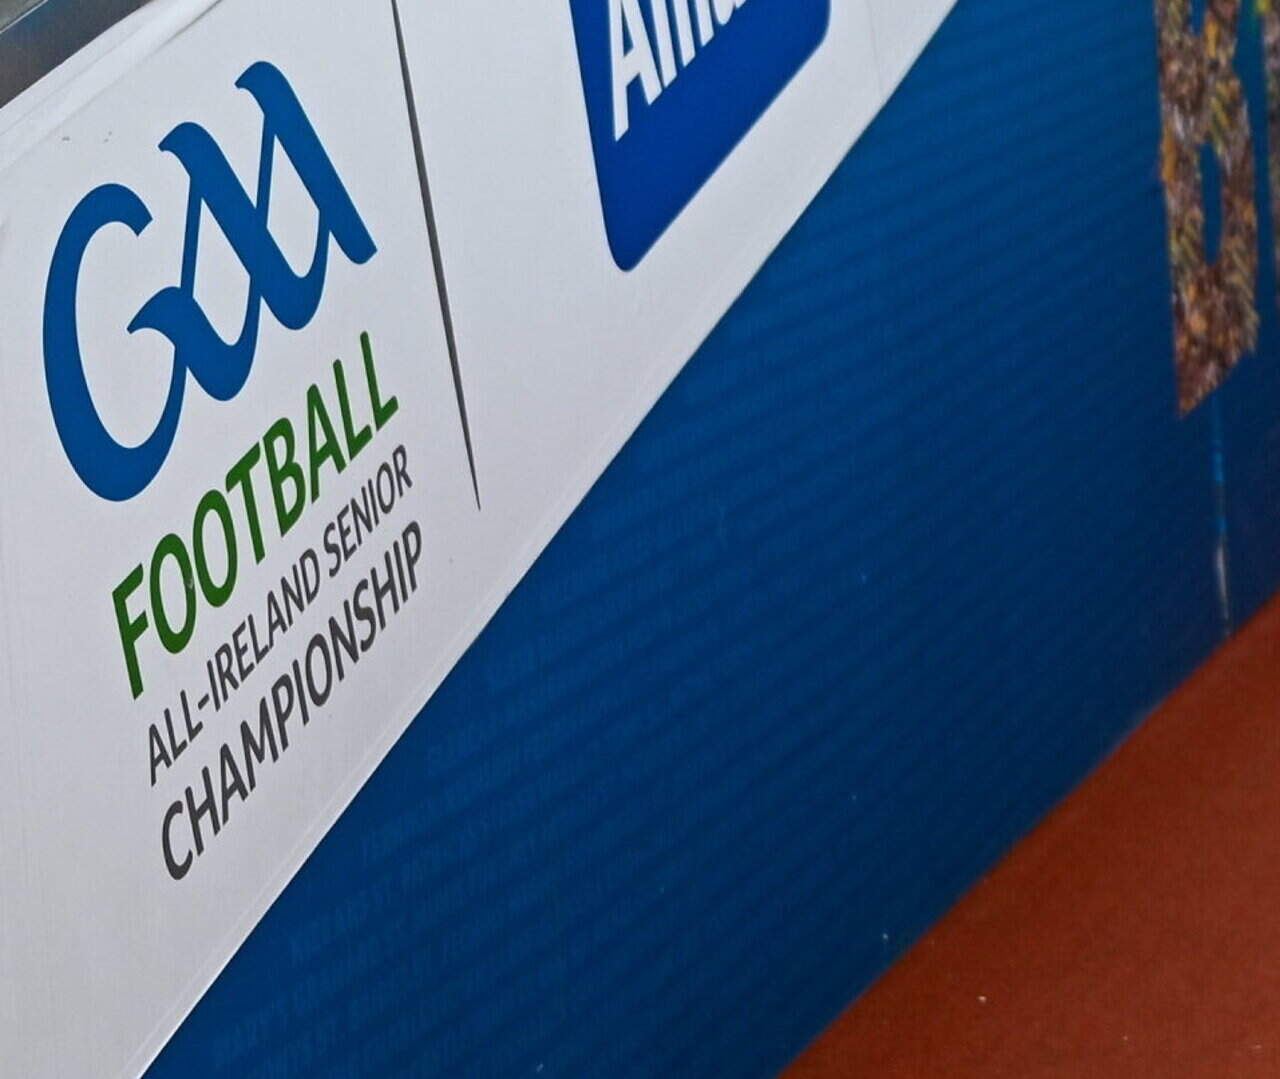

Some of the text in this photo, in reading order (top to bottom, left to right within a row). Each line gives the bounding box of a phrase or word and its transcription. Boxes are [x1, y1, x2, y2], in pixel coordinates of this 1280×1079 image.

[42, 61, 378, 502] GAA
[111, 331, 400, 701] FOOTBALL
[148, 548, 322, 787] ALL-IRELAND
[326, 444, 414, 577] SENIOR
[160, 520, 424, 882] CHAMPIONSHIP
